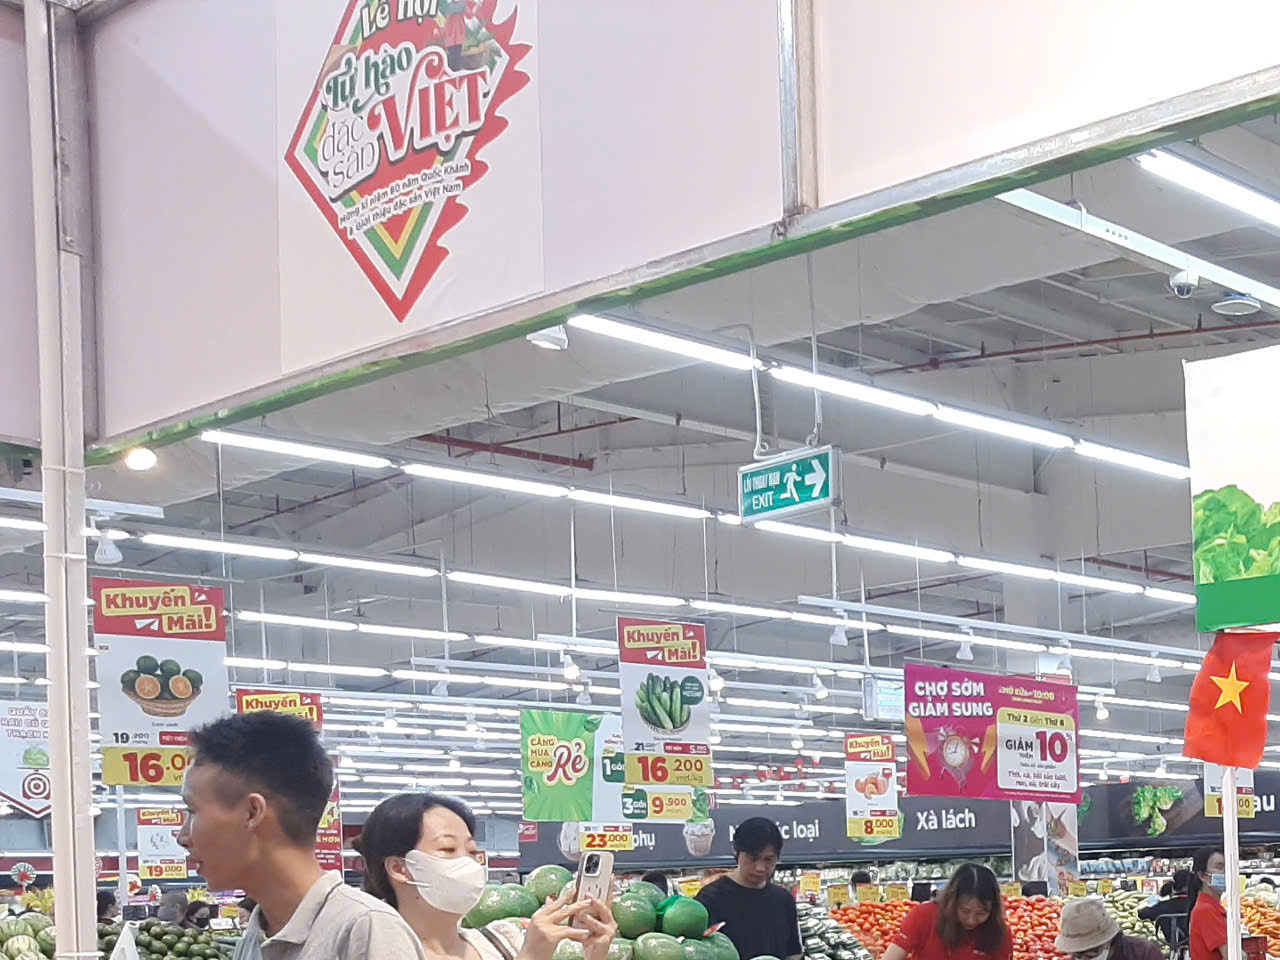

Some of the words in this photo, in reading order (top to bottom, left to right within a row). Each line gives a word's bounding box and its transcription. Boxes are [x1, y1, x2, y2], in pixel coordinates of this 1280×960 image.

[354, 45, 413, 113] hào
[367, 50, 490, 152] VIỆT
[752, 491, 774, 510] EXIT
[105, 588, 187, 611] Khuyến
[167, 607, 213, 631] Mãi!
[626, 627, 680, 645] Khuyến
[667, 642, 698, 661] Mãi!
[914, 681, 948, 697] CHỢ
[951, 680, 985, 697] SỚM
[245, 696, 297, 710] Khuyến
[909, 698, 948, 717] GIẢM
[952, 703, 993, 717] SUNG
[530, 735, 555, 747] CÀNG
[1005, 736, 1034, 752] GIẢM
[1035, 730, 1068, 763] 10
[530, 757, 553, 768] CÀNG
[531, 749, 549, 757] MUA
[547, 743, 587, 782] Rẻ
[637, 756, 669, 784] 16
[623, 798, 633, 814] 3
[652, 796, 664, 815] 9
[1254, 794, 1275, 812] au
[917, 810, 938, 832] Xà
[941, 808, 976, 829] lách
[793, 819, 820, 842] loại
[586, 834, 607, 848] 23
